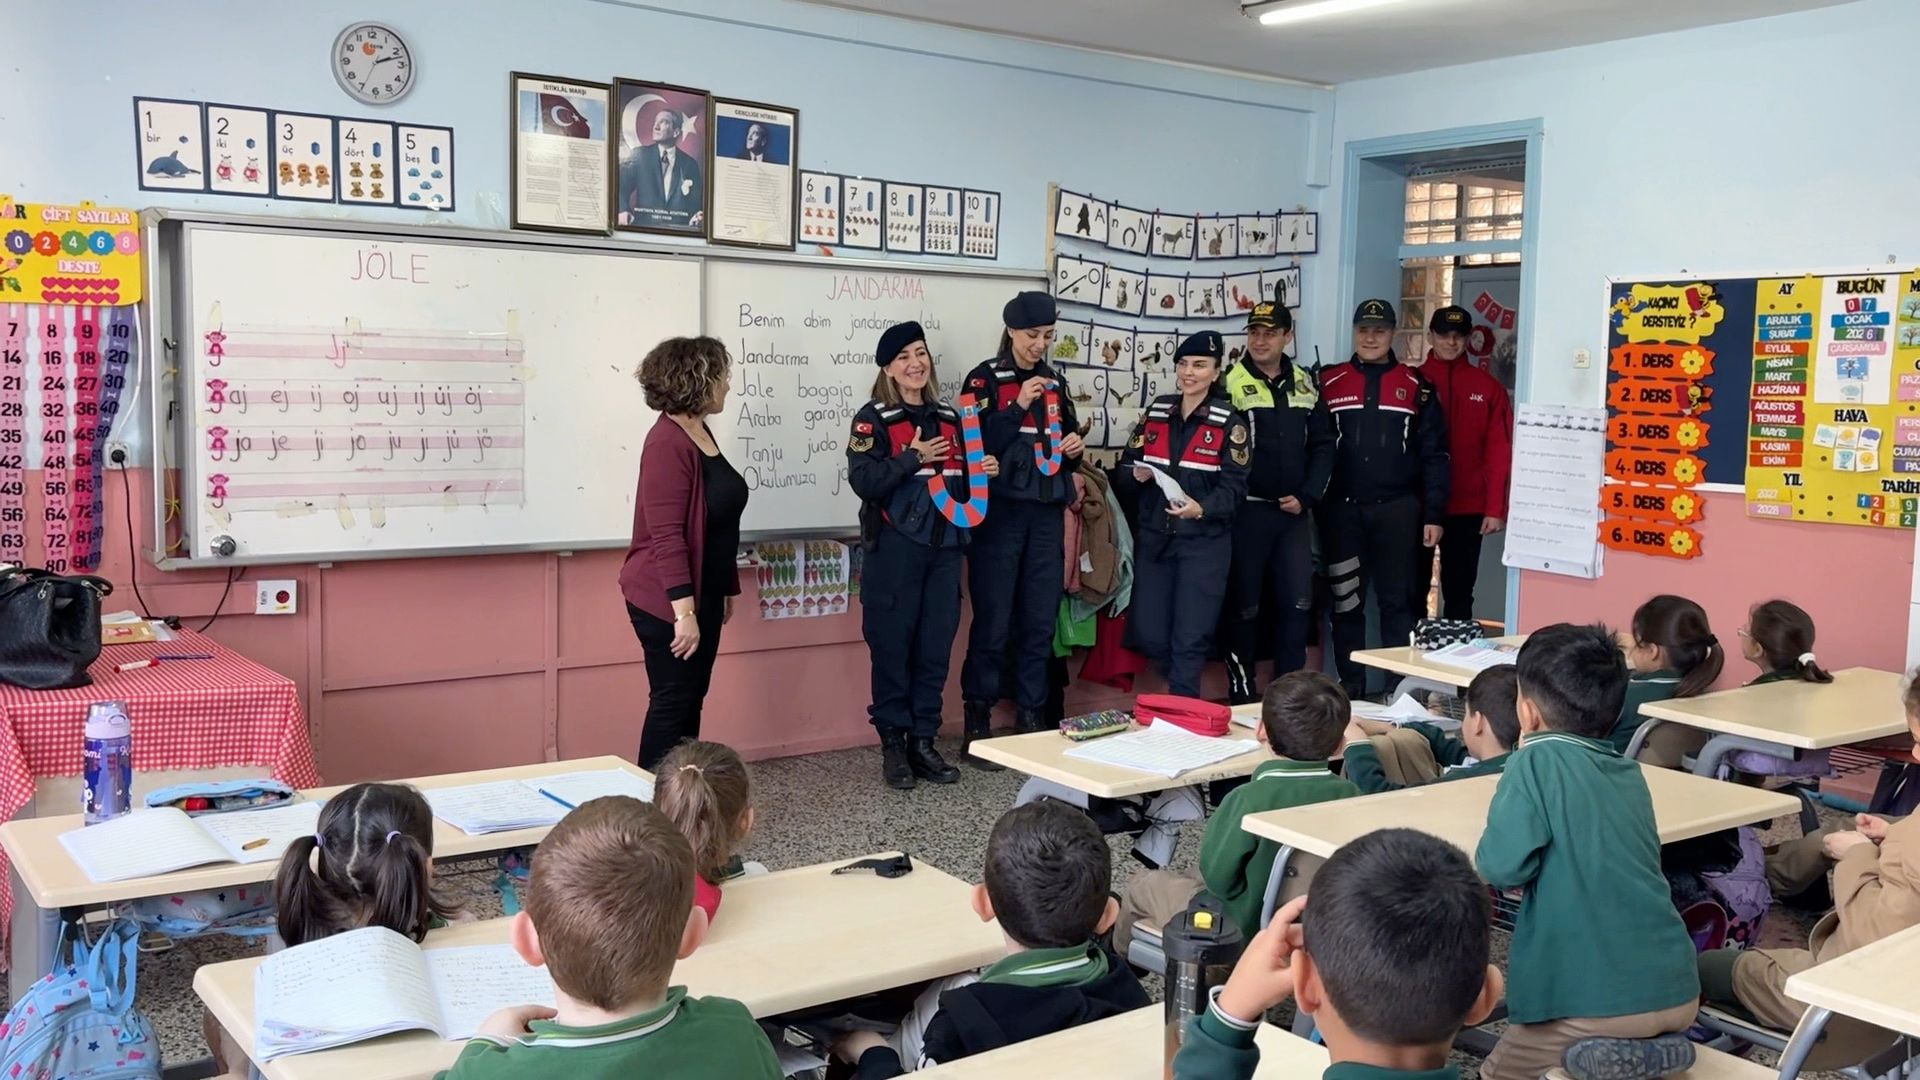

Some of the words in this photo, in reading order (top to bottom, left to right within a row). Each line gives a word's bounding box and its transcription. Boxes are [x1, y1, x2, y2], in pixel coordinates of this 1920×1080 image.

[356, 34, 362, 42] 11
[346, 44, 354, 52] 10
[343, 57, 351, 65] 9
[397, 61, 405, 69] 3
[347, 71, 356, 80] 8
[394, 75, 401, 83] 4
[372, 87, 380, 96] 6
[385, 84, 393, 92] 5
[146, 111, 152, 129] 1
[216, 117, 229, 136] 2
[146, 132, 161, 142] bir
[282, 123, 294, 141] 3
[345, 128, 357, 144] 4
[216, 138, 227, 148] iki
[406, 134, 416, 150] 5
[282, 147, 294, 156] üç
[344, 147, 365, 157] dört
[405, 153, 420, 164] beş
[806, 178, 814, 192] 6
[850, 186, 858, 200] 7
[891, 192, 897, 206] 8
[930, 192, 936, 205] 9
[968, 196, 980, 210] 10
[42, 207, 71, 224] ÇİFT
[77, 210, 132, 224] SAYILAR
[929, 208, 946, 217] dokuz
[1095, 209, 1106, 224] A
[1112, 219, 1119, 228] n
[1138, 218, 1150, 234] N
[1155, 227, 1162, 236] e
[1185, 223, 1192, 238] E
[1228, 224, 1235, 239] T
[1306, 220, 1313, 235] L
[14, 236, 23, 249] 0
[42, 237, 51, 249] 2
[69, 236, 78, 248] 4
[97, 236, 105, 248] 6
[122, 236, 130, 249] 8
[58, 260, 101, 273] DESTE
[350, 244, 430, 284] JÖLE
[826, 275, 925, 301] JANDARMA
[1060, 270, 1068, 280] o
[1088, 268, 1101, 285] O
[1105, 274, 1111, 289] k
[1134, 279, 1143, 295] K
[1216, 283, 1223, 299] R
[1265, 283, 1273, 291] m
[1287, 275, 1297, 288] M
[1778, 283, 1795, 295] AY
[1836, 278, 1886, 294] BUGÜN
[739, 304, 785, 328] Benim
[803, 309, 832, 328] abim
[1642, 314, 1687, 328] DERSTEYİZ
[1766, 316, 1802, 325] ARALIK
[1844, 315, 1873, 325] OCAK
[8, 323, 18, 337] 7
[47, 324, 57, 338] 8
[82, 324, 93, 339] 9
[112, 324, 129, 339] 10
[1768, 329, 1797, 339] ŞUBAT
[1845, 329, 1873, 340] 2026
[738, 337, 808, 366] Jandarma
[1124, 337, 1132, 353] S
[1137, 341, 1144, 353] ö
[1164, 336, 1175, 356] Ö
[1765, 343, 1793, 353] EYLÜL
[1830, 343, 1881, 354] ÇARŞAMBA
[2, 350, 22, 364] 14
[44, 351, 62, 365] 16
[79, 352, 96, 365] 18
[108, 349, 129, 364] 20
[1642, 353, 1674, 368] DERS
[1766, 357, 1794, 369] NİSAN
[3, 376, 21, 390] 21
[43, 377, 65, 390] 24
[78, 377, 98, 391] 27
[104, 374, 124, 389] 30
[1765, 373, 1792, 381] MART
[737, 368, 775, 398] Jale
[798, 373, 853, 408] bagaja
[1094, 375, 1105, 394] Ç
[1132, 376, 1140, 392] B
[1149, 380, 1156, 397] g
[1758, 382, 1800, 394] HAZİRAN
[271, 379, 289, 413] ej
[311, 384, 322, 413] ij
[343, 383, 360, 413] oj
[378, 384, 398, 416] uj
[1640, 388, 1672, 404] DERS
[1, 403, 22, 417] 28
[43, 403, 64, 417] 32
[76, 402, 98, 416] 36
[100, 401, 119, 415] 40
[1754, 402, 1796, 412] AĞUSTOS
[737, 402, 782, 428] Araba
[1092, 411, 1103, 426] H
[1756, 414, 1797, 424] TEMMUZ
[1834, 409, 1868, 423] HAVA
[0, 430, 22, 443] 35
[44, 430, 66, 444] 40
[75, 428, 96, 442] 45
[96, 426, 111, 438] 50
[1638, 424, 1670, 439] DERS
[1760, 427, 1787, 438] MAYIS
[267, 430, 292, 461] je
[312, 429, 324, 462] ji
[346, 427, 366, 461] jo
[383, 430, 401, 461] ju
[414, 428, 429, 463] jı
[443, 429, 460, 463] jü
[473, 428, 493, 464] jö
[737, 437, 783, 471] Tanju
[804, 432, 838, 463] judo
[1760, 443, 1790, 451] KASIM
[0, 456, 22, 469] 42
[44, 456, 66, 470] 48
[1763, 455, 1786, 465] EKİM
[1634, 460, 1666, 476] DERS
[742, 466, 817, 491] Okulumuza
[1783, 473, 1803, 486] YIL
[0, 482, 23, 496] 49
[45, 482, 66, 495] 56
[1881, 479, 1920, 494] TARİH
[1633, 494, 1665, 511] DERS
[1873, 497, 1880, 507] 2
[1906, 500, 1913, 510] 9
[2, 508, 23, 521] 56
[45, 508, 67, 521] 64
[1873, 513, 1880, 522] 4
[1905, 515, 1912, 525] 2
[1, 535, 24, 548] 63
[47, 534, 66, 548] 72
[1633, 530, 1665, 546] DERS
[45, 560, 67, 573] 80
